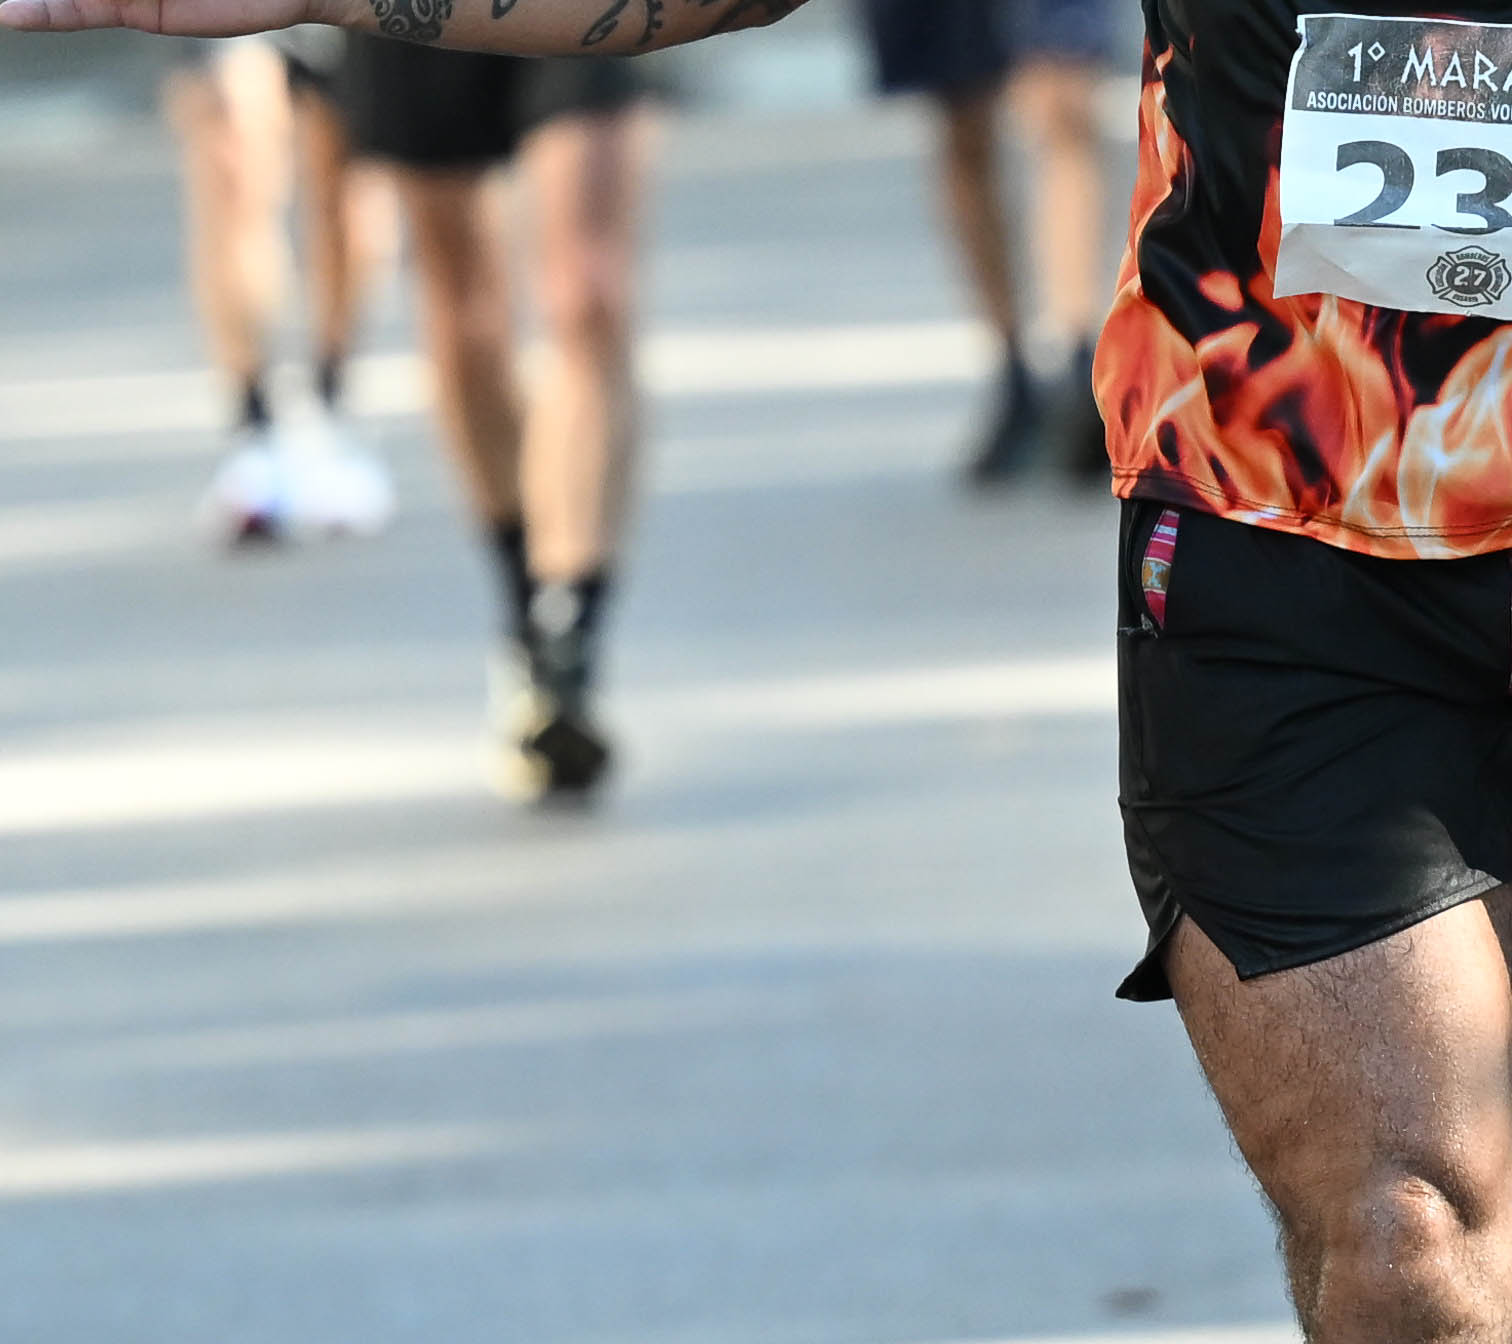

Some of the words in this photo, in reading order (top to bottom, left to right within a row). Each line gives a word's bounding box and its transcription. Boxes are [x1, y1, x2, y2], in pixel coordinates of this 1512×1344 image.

[1306, 89, 1398, 114] ASOCIACIÓN
[1402, 96, 1486, 120] BOMBEROS
[1454, 265, 1487, 287] 27
